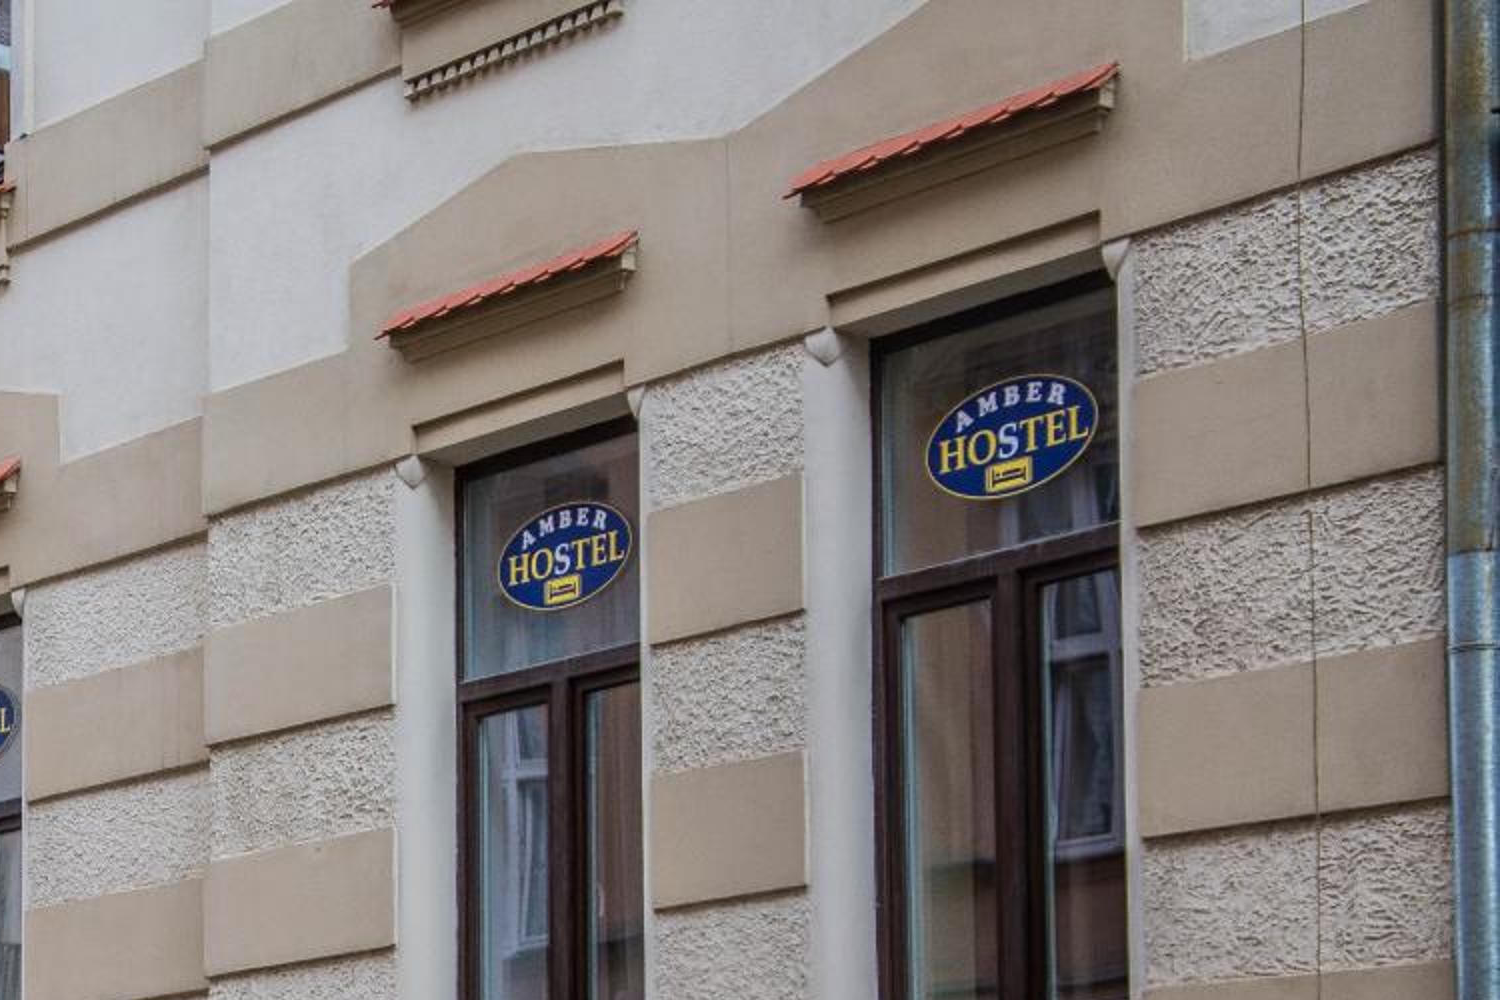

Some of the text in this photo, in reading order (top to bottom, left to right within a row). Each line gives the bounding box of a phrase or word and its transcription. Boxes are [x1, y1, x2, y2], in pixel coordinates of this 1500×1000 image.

[955, 381, 1067, 433] AMBER
[938, 405, 1089, 475] HOSTEL
[521, 507, 608, 550] AMBER
[508, 529, 625, 587] HOSTEL
